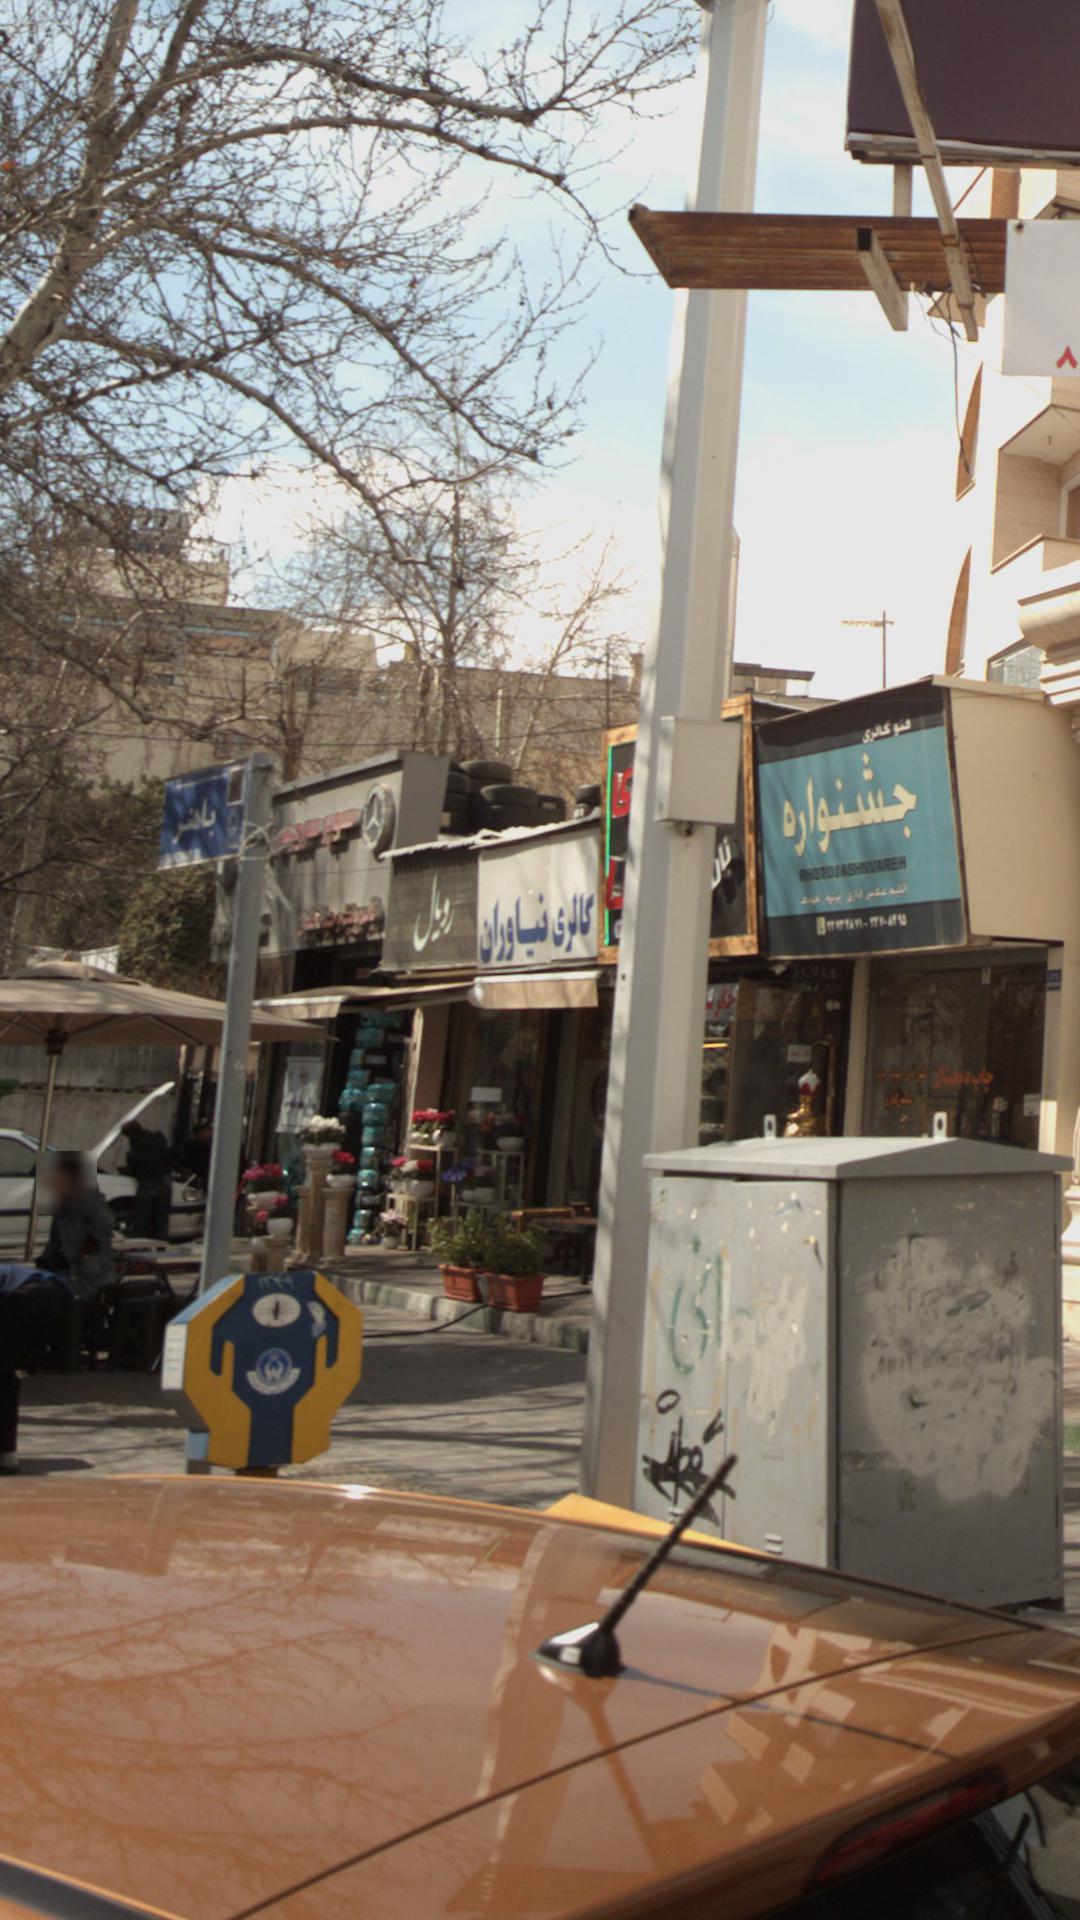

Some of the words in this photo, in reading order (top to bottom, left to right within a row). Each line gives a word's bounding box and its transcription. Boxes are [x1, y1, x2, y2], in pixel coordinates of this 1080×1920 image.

[862, 720, 891, 744] گالری
[783, 752, 917, 857] جشنواره
[480, 892, 549, 964] نیاوران
[552, 892, 595, 953] گالری
